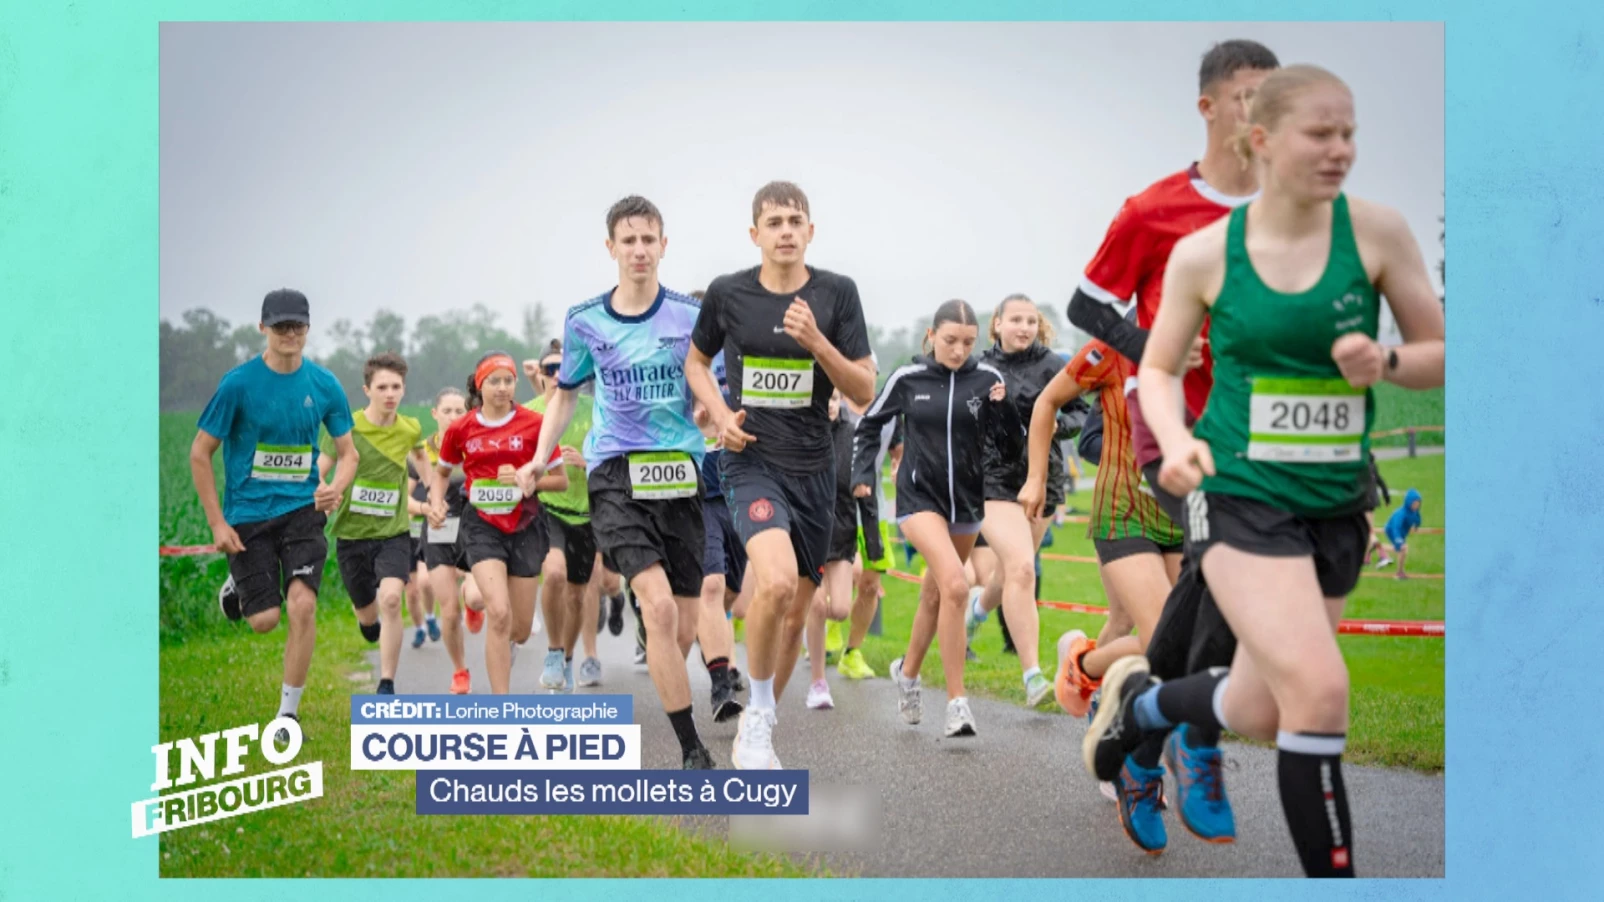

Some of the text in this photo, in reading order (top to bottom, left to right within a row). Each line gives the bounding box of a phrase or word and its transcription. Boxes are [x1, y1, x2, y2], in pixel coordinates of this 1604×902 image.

[600, 363, 684, 387] Emirates
[752, 371, 802, 391] 2007
[635, 382, 675, 401] BETTER
[1270, 401, 1350, 431] 2048
[263, 454, 304, 468] 2054
[639, 463, 687, 483] 2006
[359, 488, 394, 504] 2027
[477, 488, 514, 502] 2056
